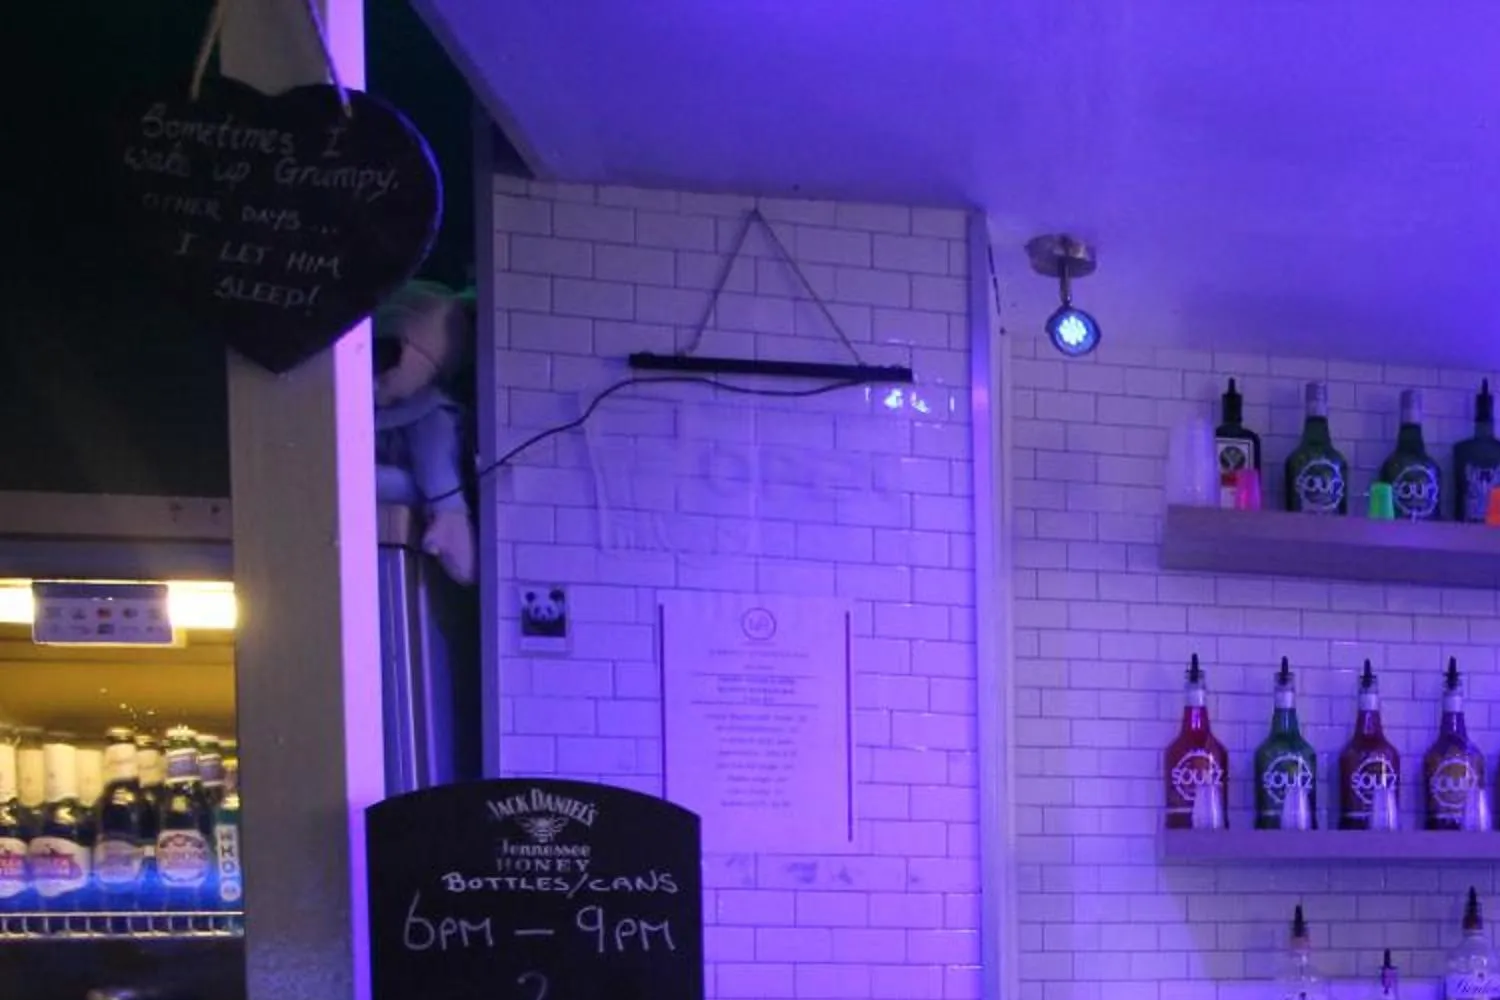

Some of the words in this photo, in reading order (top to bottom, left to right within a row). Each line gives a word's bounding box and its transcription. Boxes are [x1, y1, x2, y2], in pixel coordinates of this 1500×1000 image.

[141, 102, 296, 156] Sometimes
[321, 125, 347, 158] I
[173, 230, 198, 256] I
[218, 240, 270, 265] LET
[486, 794, 530, 822] JACK
[496, 857, 591, 874] HONEY
[403, 890, 496, 951] 6PM
[576, 904, 677, 953] 9PM
